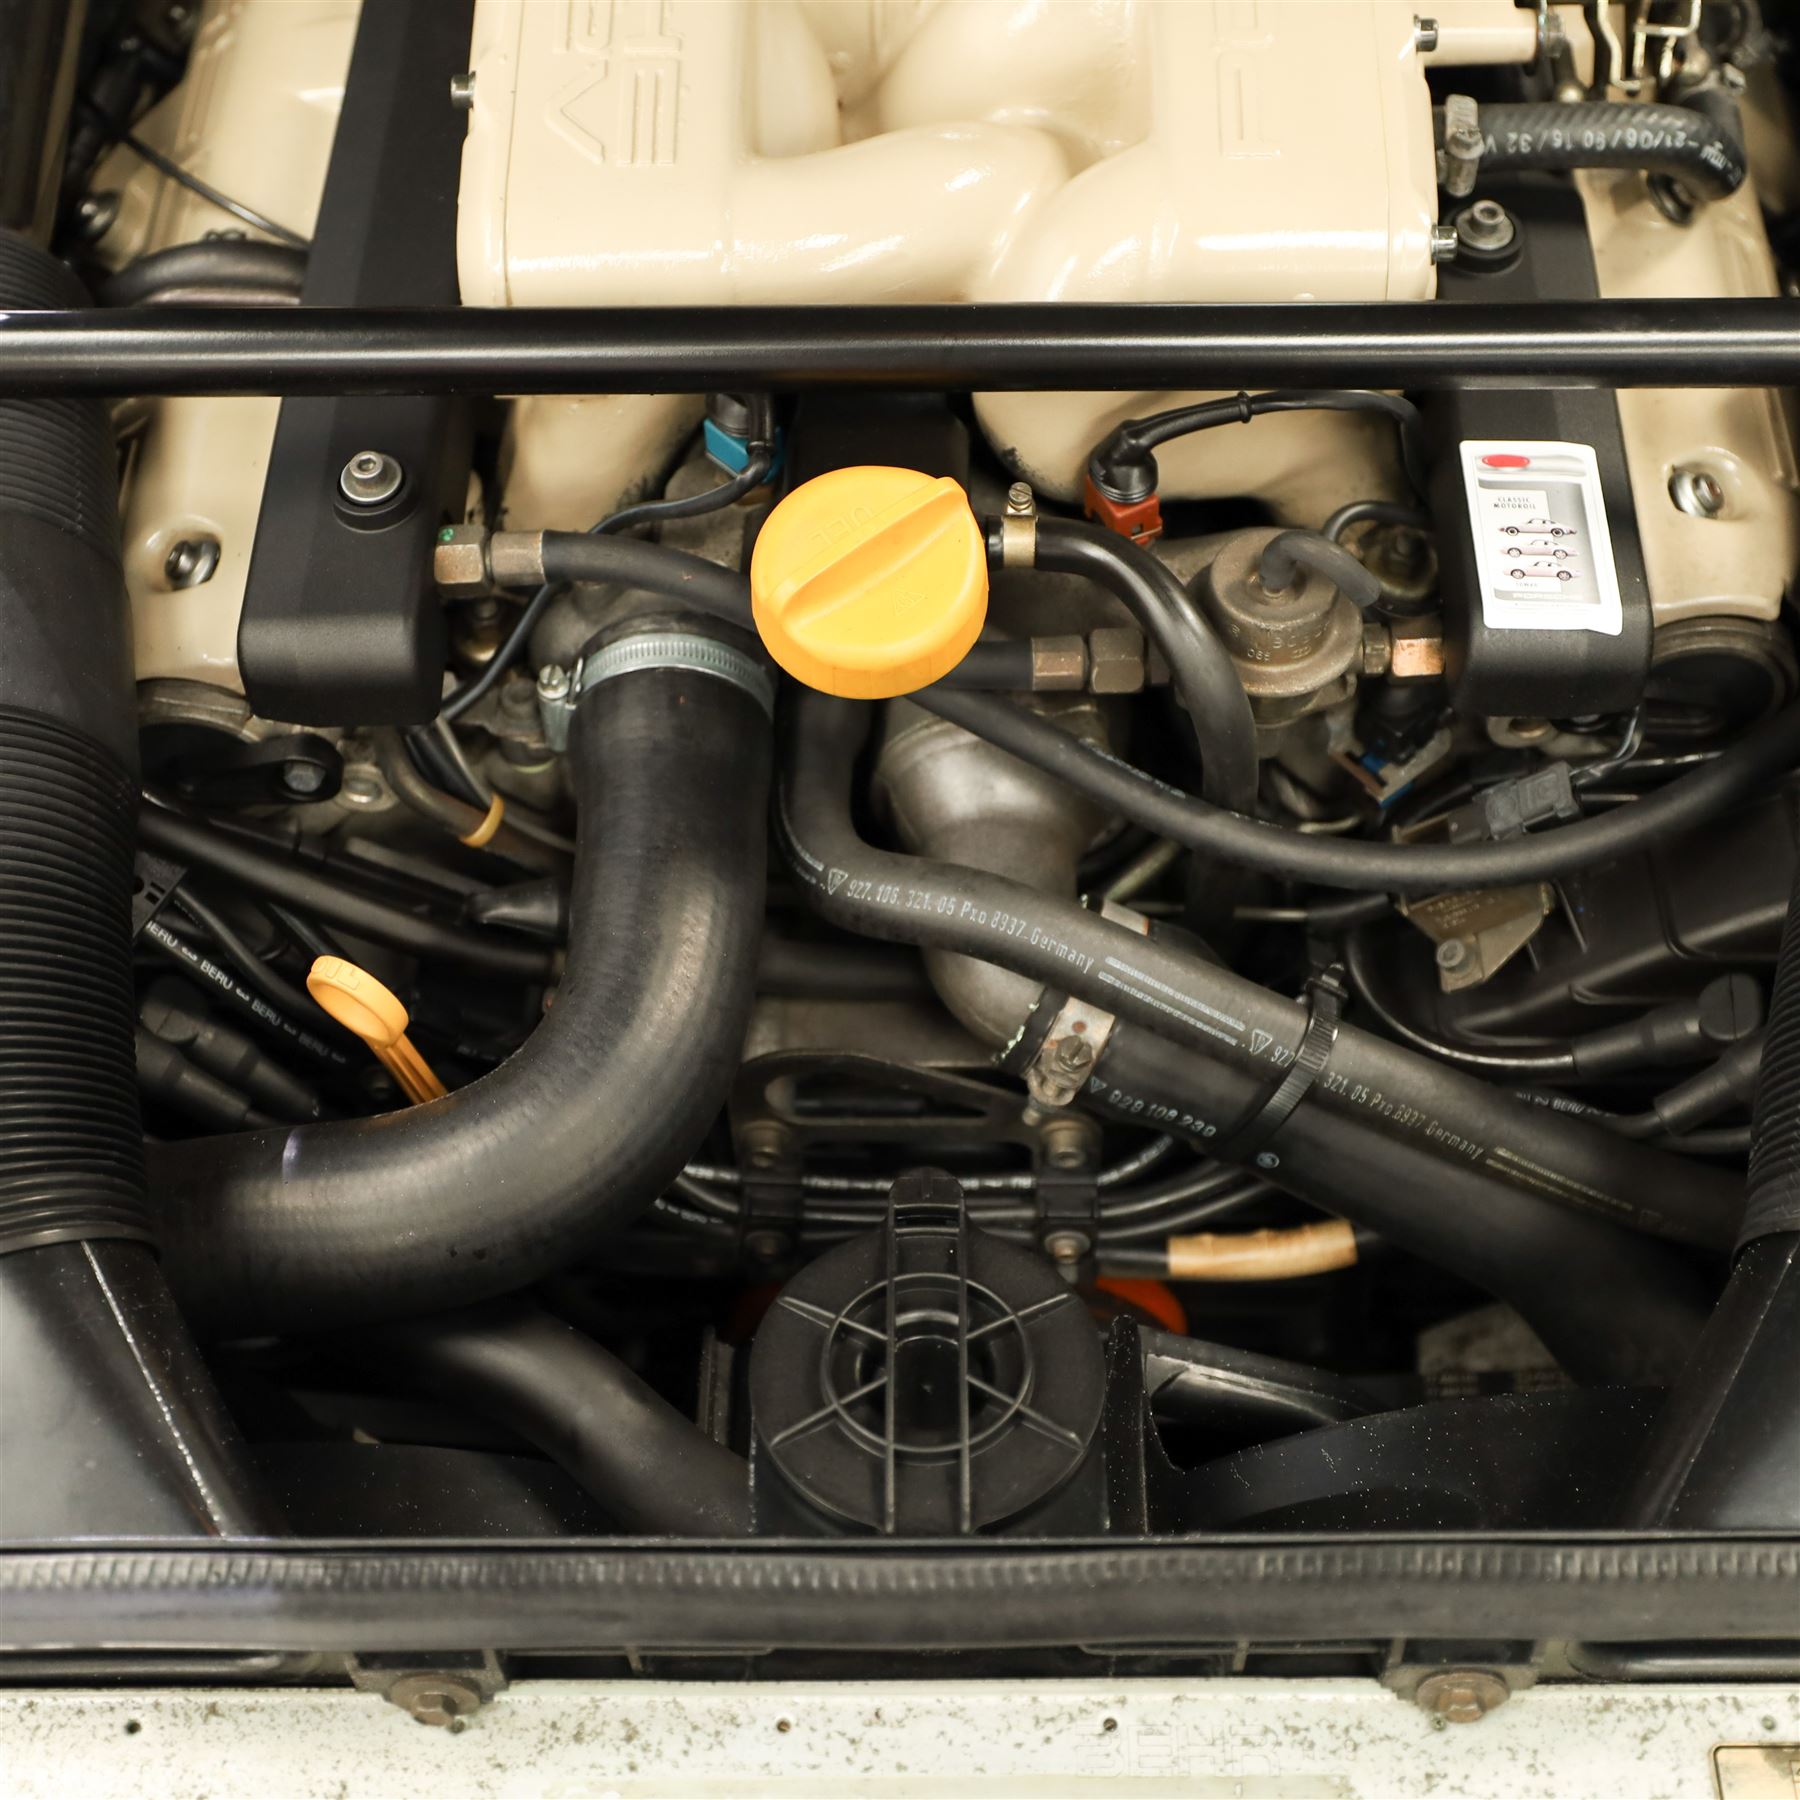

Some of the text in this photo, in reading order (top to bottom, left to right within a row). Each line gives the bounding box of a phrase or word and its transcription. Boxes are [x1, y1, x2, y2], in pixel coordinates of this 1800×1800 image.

[937, 893, 956, 917] 05
[1030, 926, 1096, 974] Germany
[200, 958, 235, 991] BERU
[250, 1000, 283, 1029] BERU
[1426, 1121, 1485, 1160] Germany
[1074, 1723, 1281, 1778] BEHR
